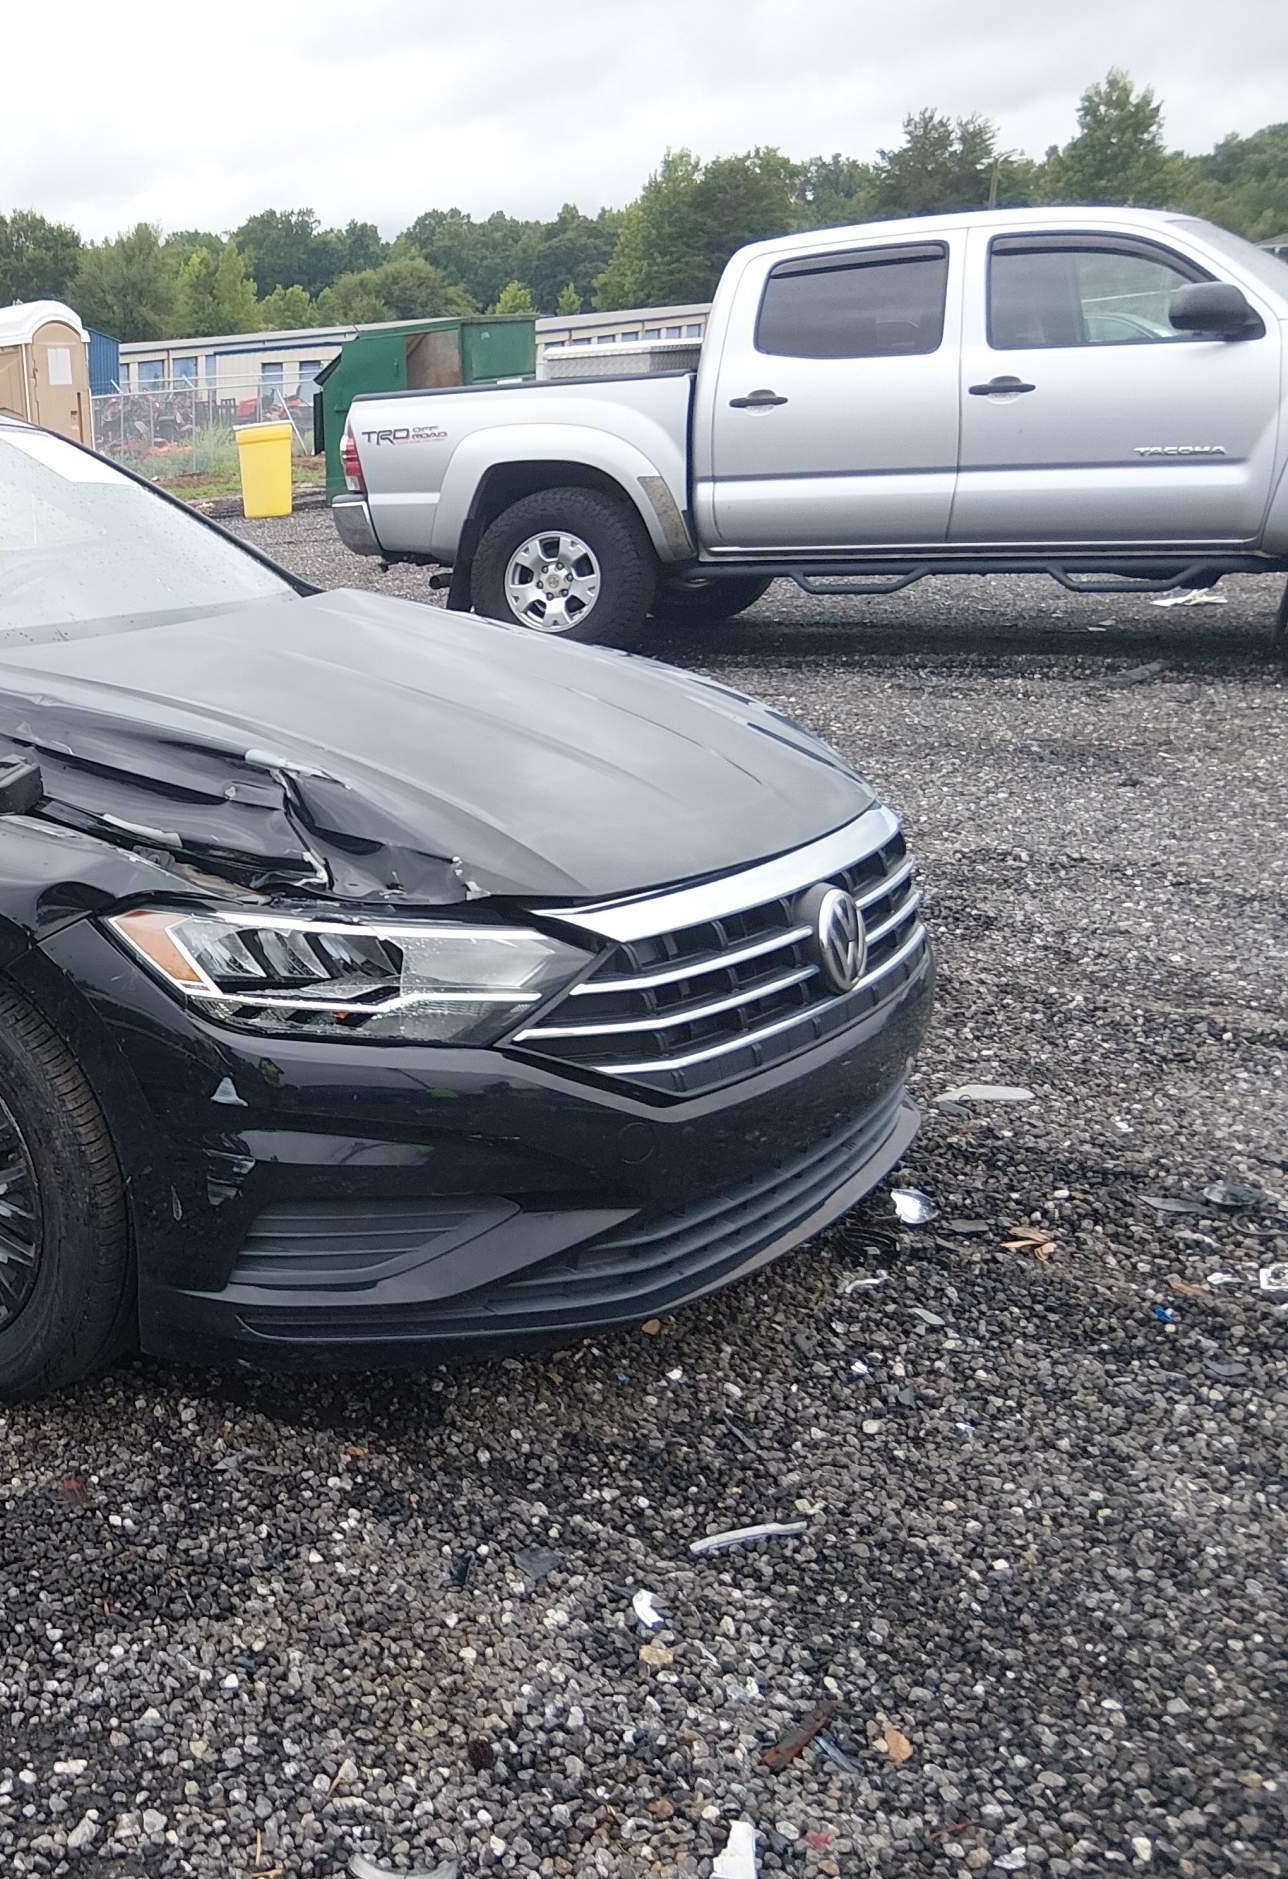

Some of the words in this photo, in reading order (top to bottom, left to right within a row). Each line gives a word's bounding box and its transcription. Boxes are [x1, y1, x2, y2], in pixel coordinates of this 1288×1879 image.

[361, 428, 410, 446] TRD
[412, 431, 448, 440] ROAD
[1133, 446, 1226, 456] TACOMA
